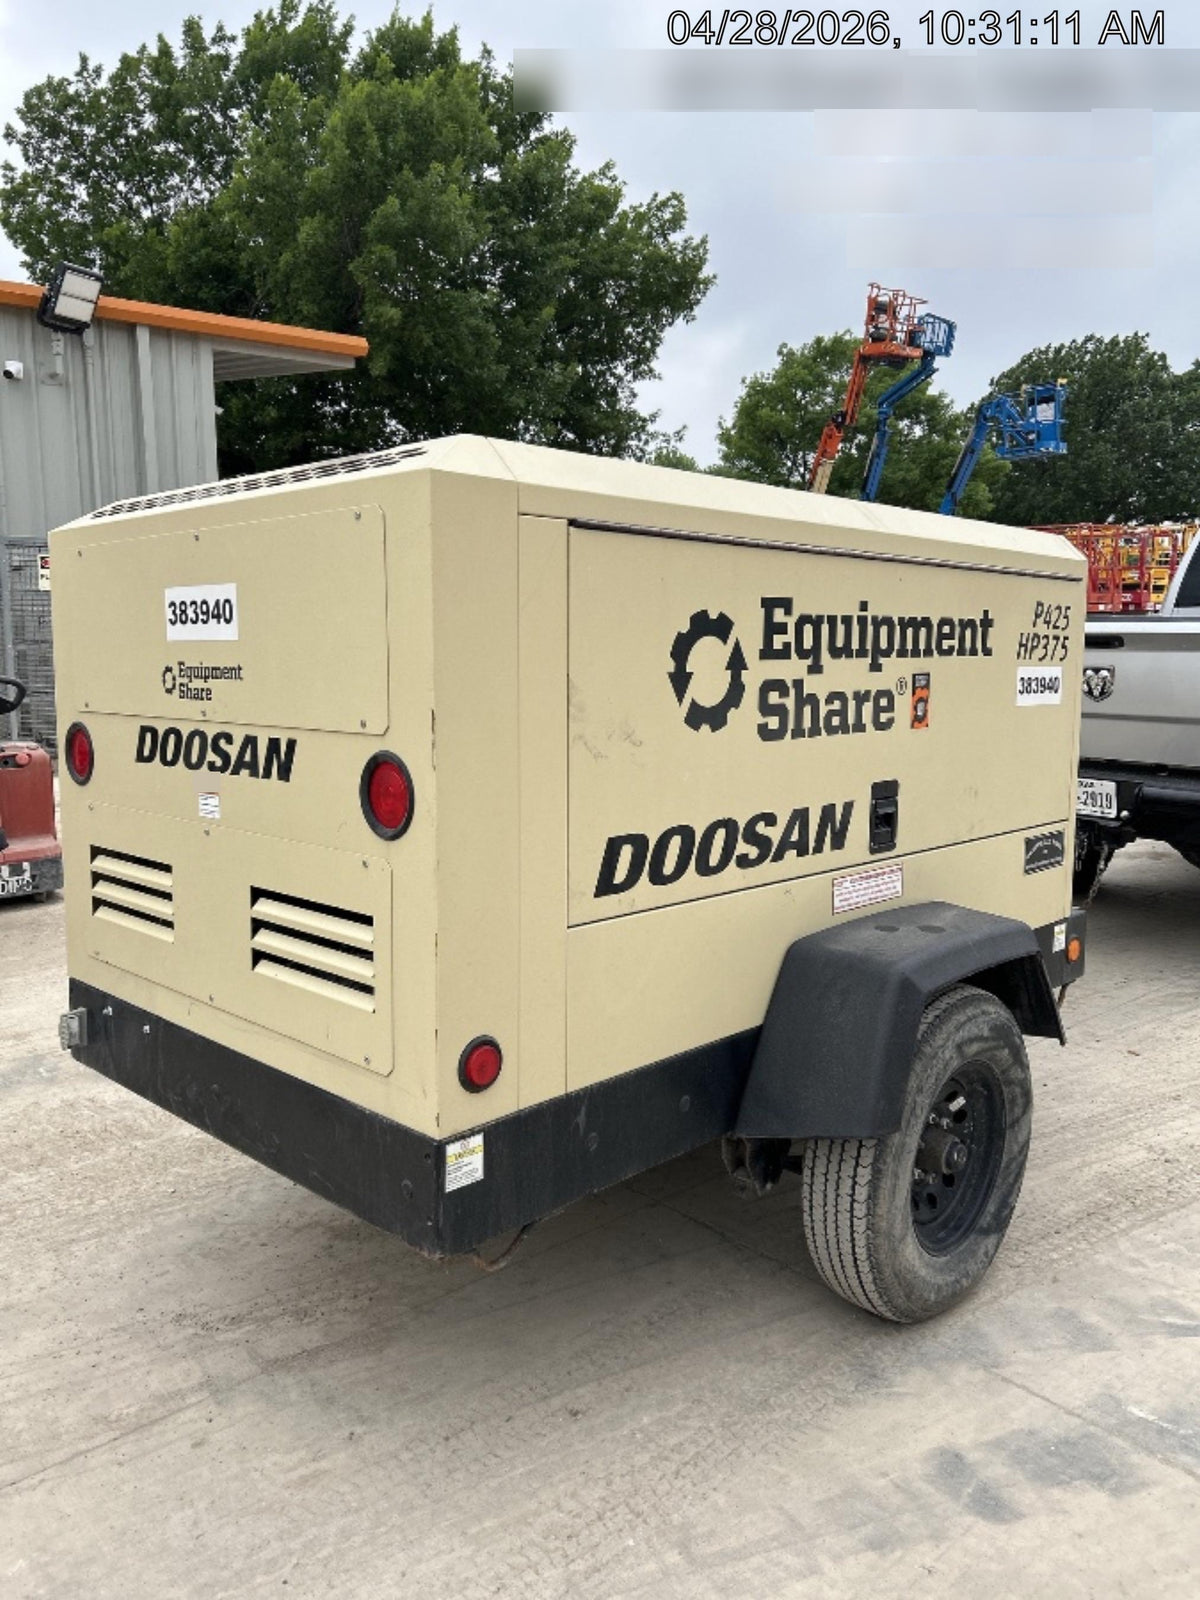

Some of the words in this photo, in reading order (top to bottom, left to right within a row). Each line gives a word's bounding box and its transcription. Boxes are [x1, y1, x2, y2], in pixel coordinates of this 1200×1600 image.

[168, 598, 233, 626] 383940
[1033, 600, 1072, 631] P425
[757, 597, 994, 676] Equipment
[1016, 632, 1070, 662] HP375
[177, 660, 243, 682] Equipment
[1018, 677, 1060, 695] 383940
[179, 682, 213, 701] Share
[136, 724, 297, 783] DOOSAN
[594, 800, 856, 899] DOOSAN
